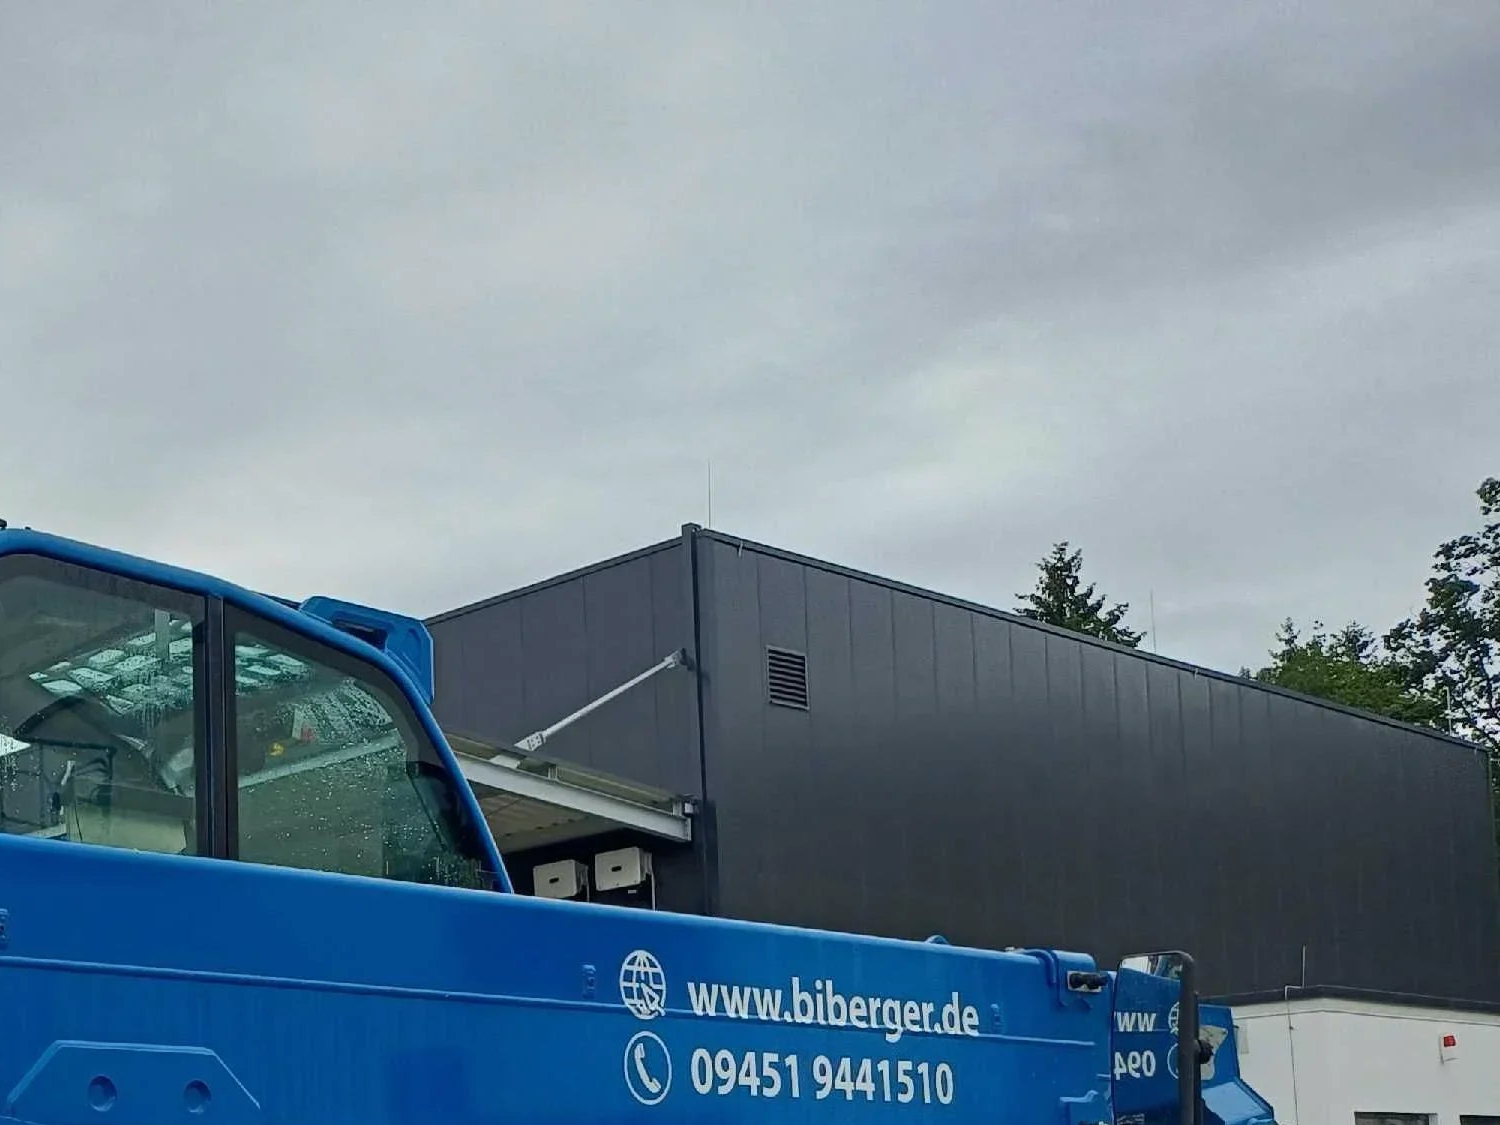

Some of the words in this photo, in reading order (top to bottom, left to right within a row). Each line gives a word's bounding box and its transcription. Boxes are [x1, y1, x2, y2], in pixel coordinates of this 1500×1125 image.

[688, 976, 980, 1043] www.biberger.de
[691, 1048, 800, 1098] 09451
[813, 1055, 954, 1104] 9441510
